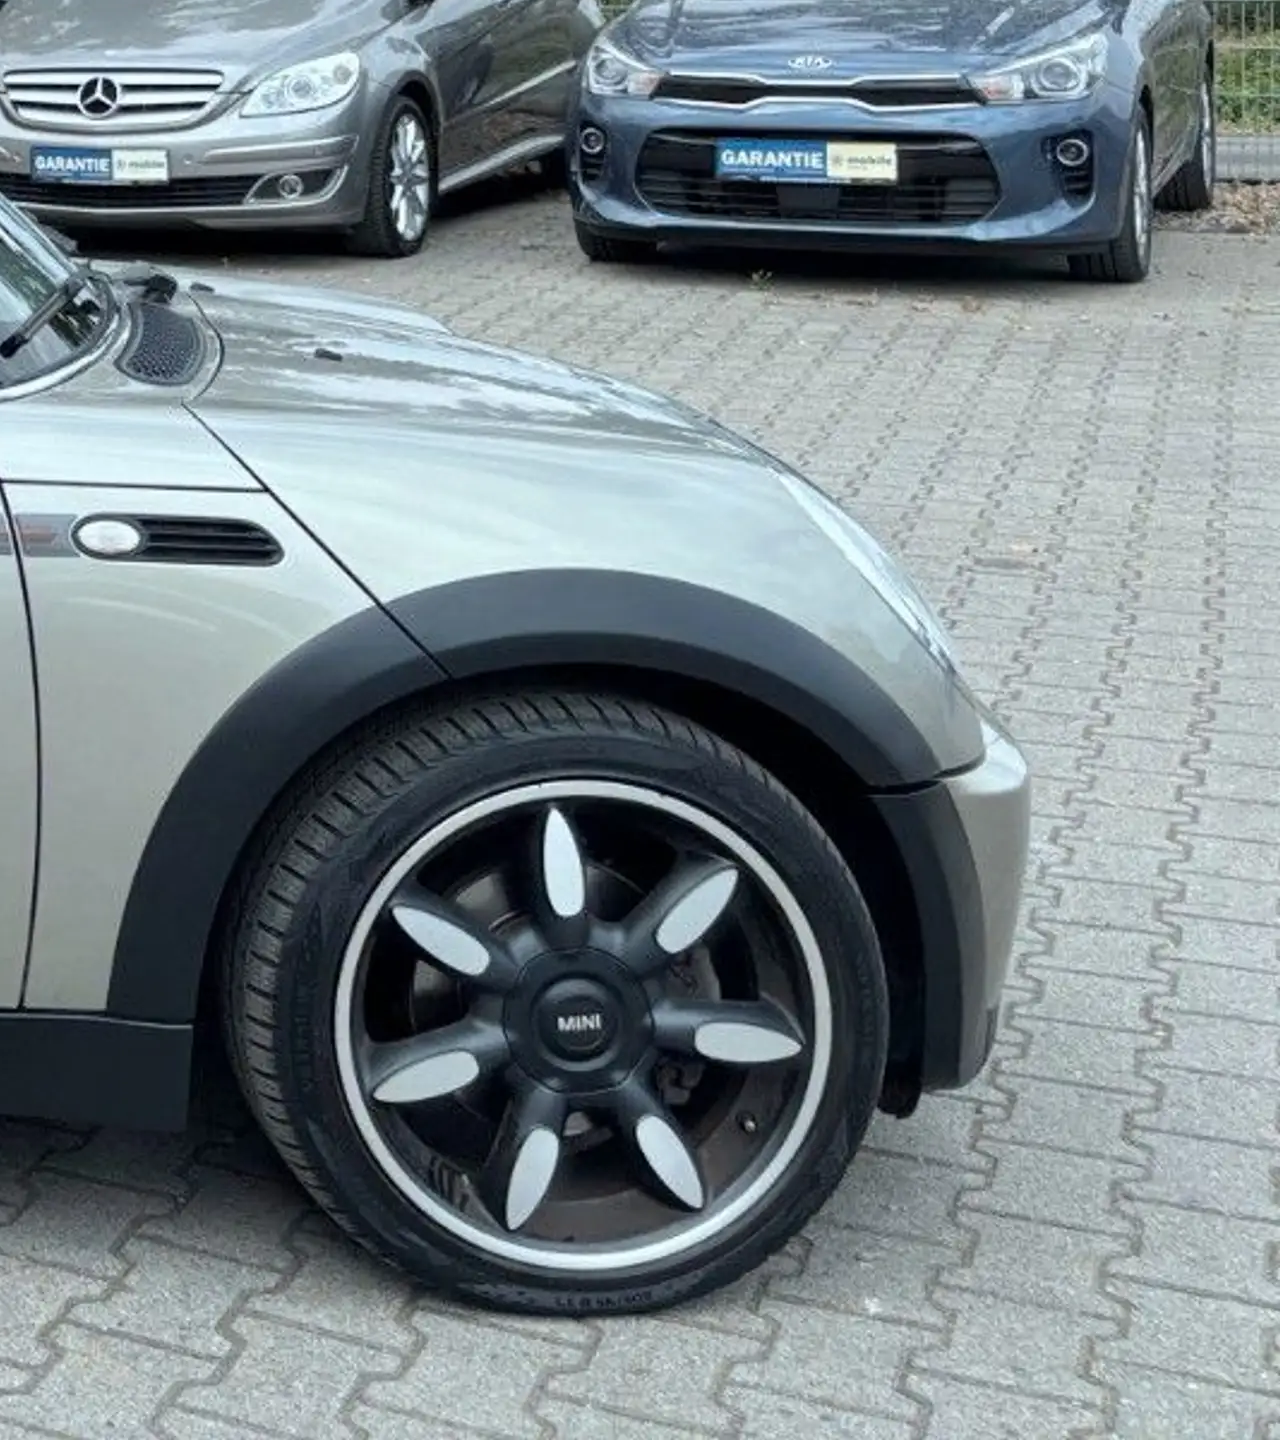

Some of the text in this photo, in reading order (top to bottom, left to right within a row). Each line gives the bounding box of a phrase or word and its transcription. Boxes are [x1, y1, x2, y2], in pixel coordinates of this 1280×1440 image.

[34, 155, 111, 173] GARANTIE
[720, 149, 824, 169] GARANTIE
[556, 1013, 603, 1032] MINI
